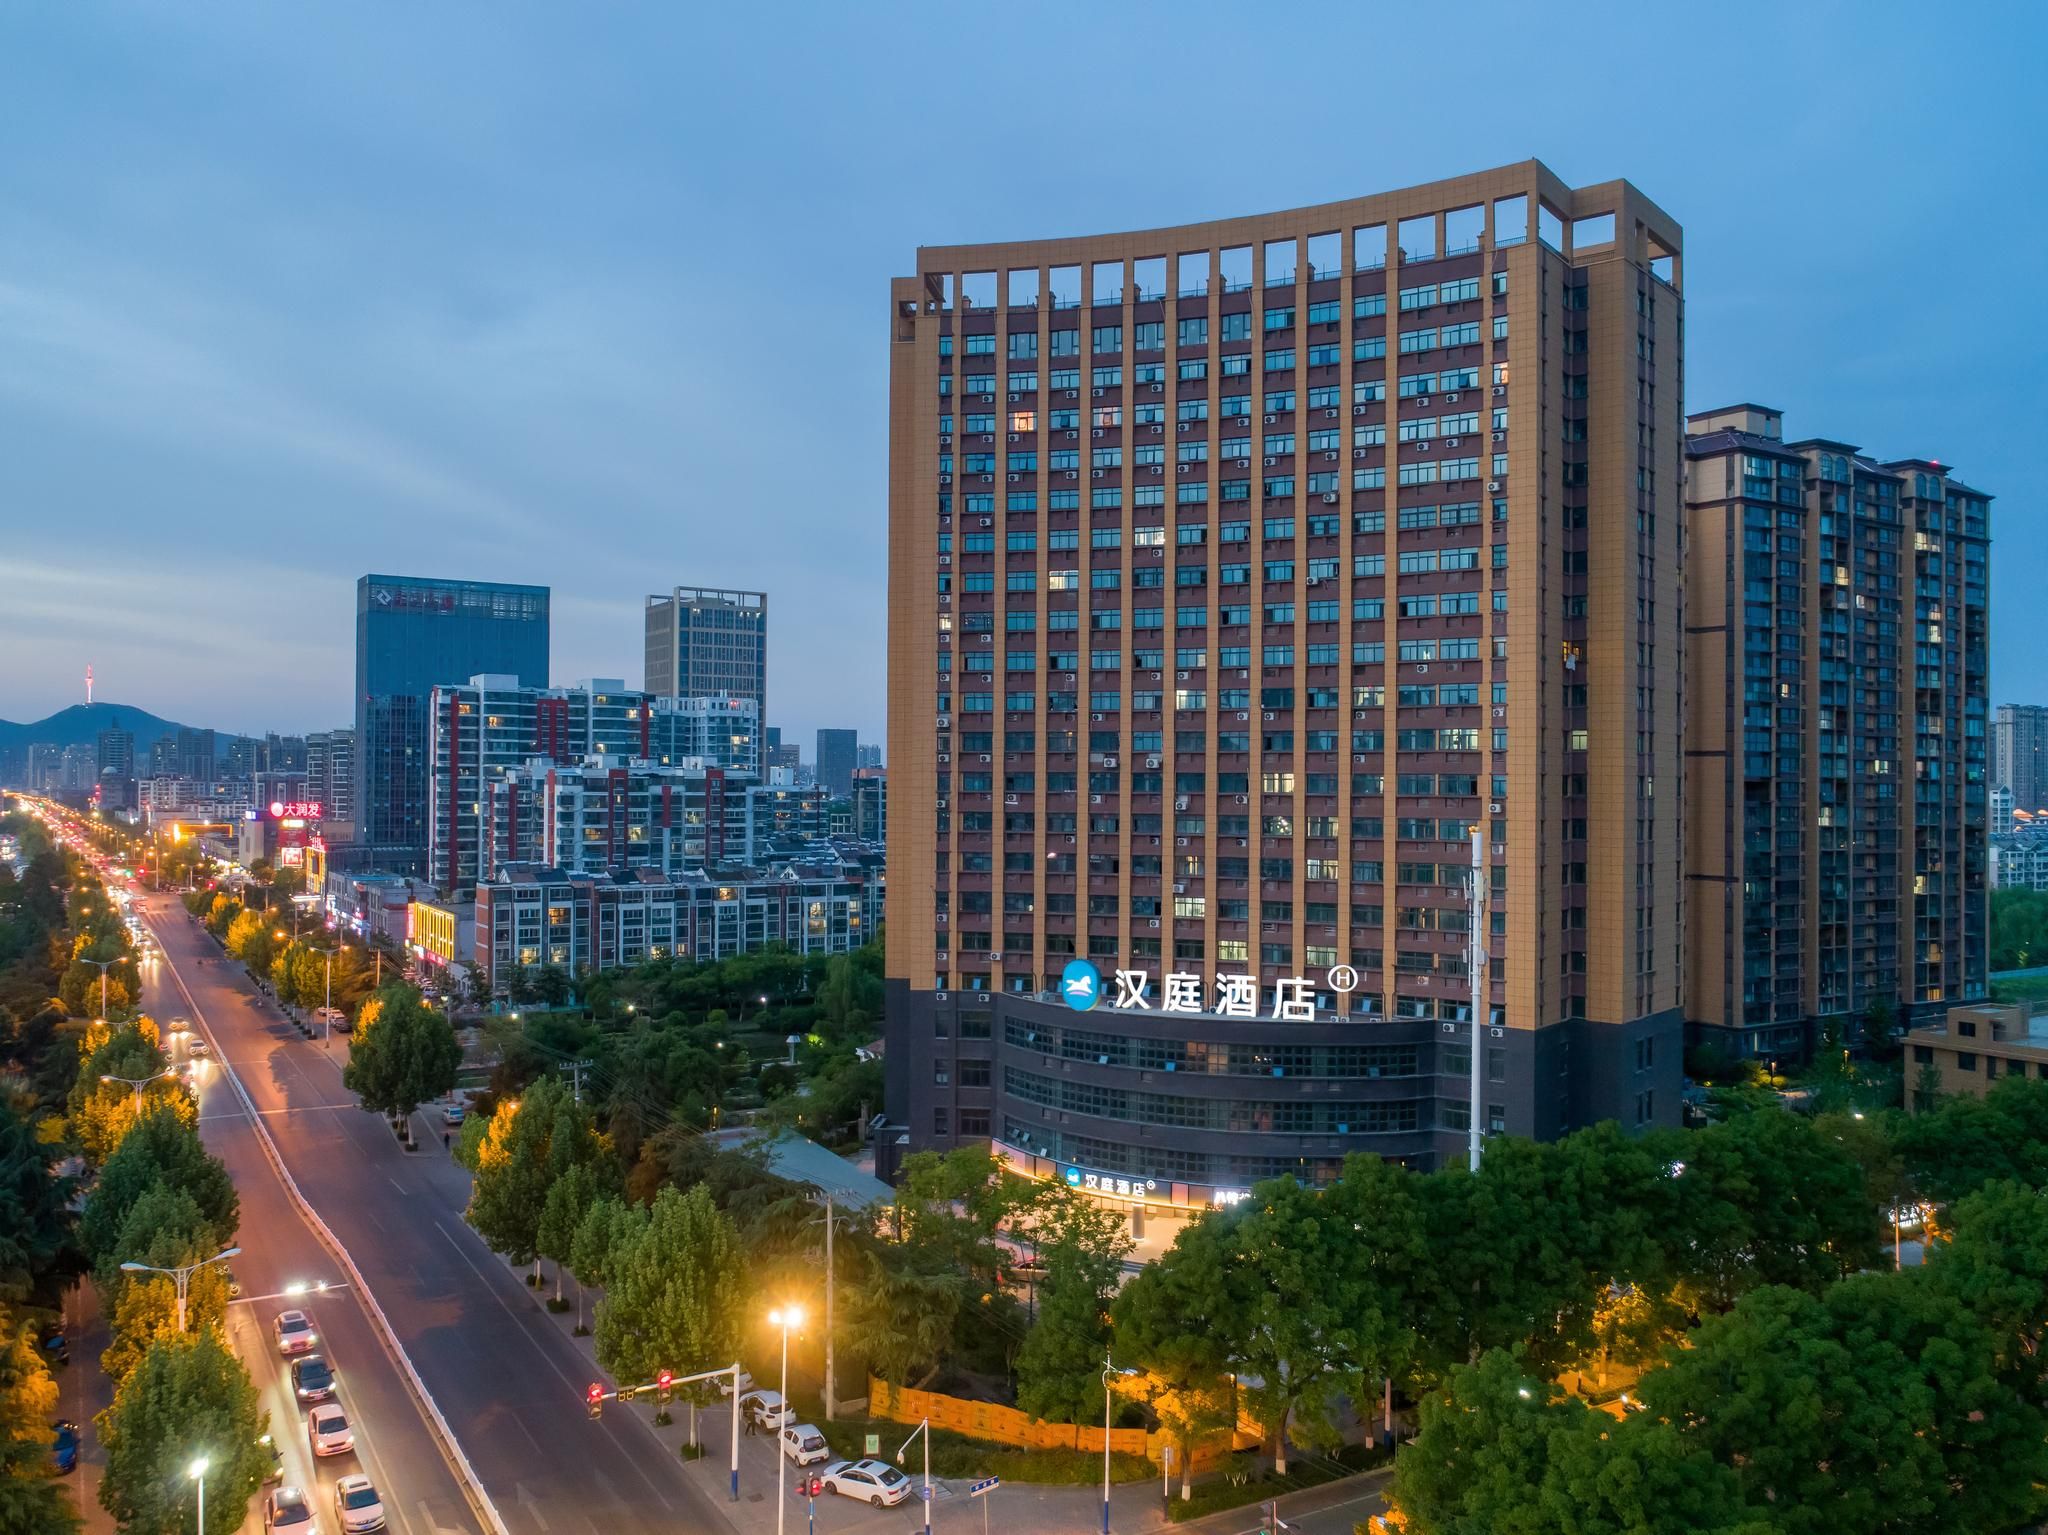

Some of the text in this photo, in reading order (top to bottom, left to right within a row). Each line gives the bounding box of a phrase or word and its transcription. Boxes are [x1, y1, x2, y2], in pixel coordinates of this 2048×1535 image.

[284, 803, 319, 816] 大润发
[1115, 968, 1316, 1022] 汉庭酒店
[1085, 1173, 1145, 1197] 汉庭酒店
